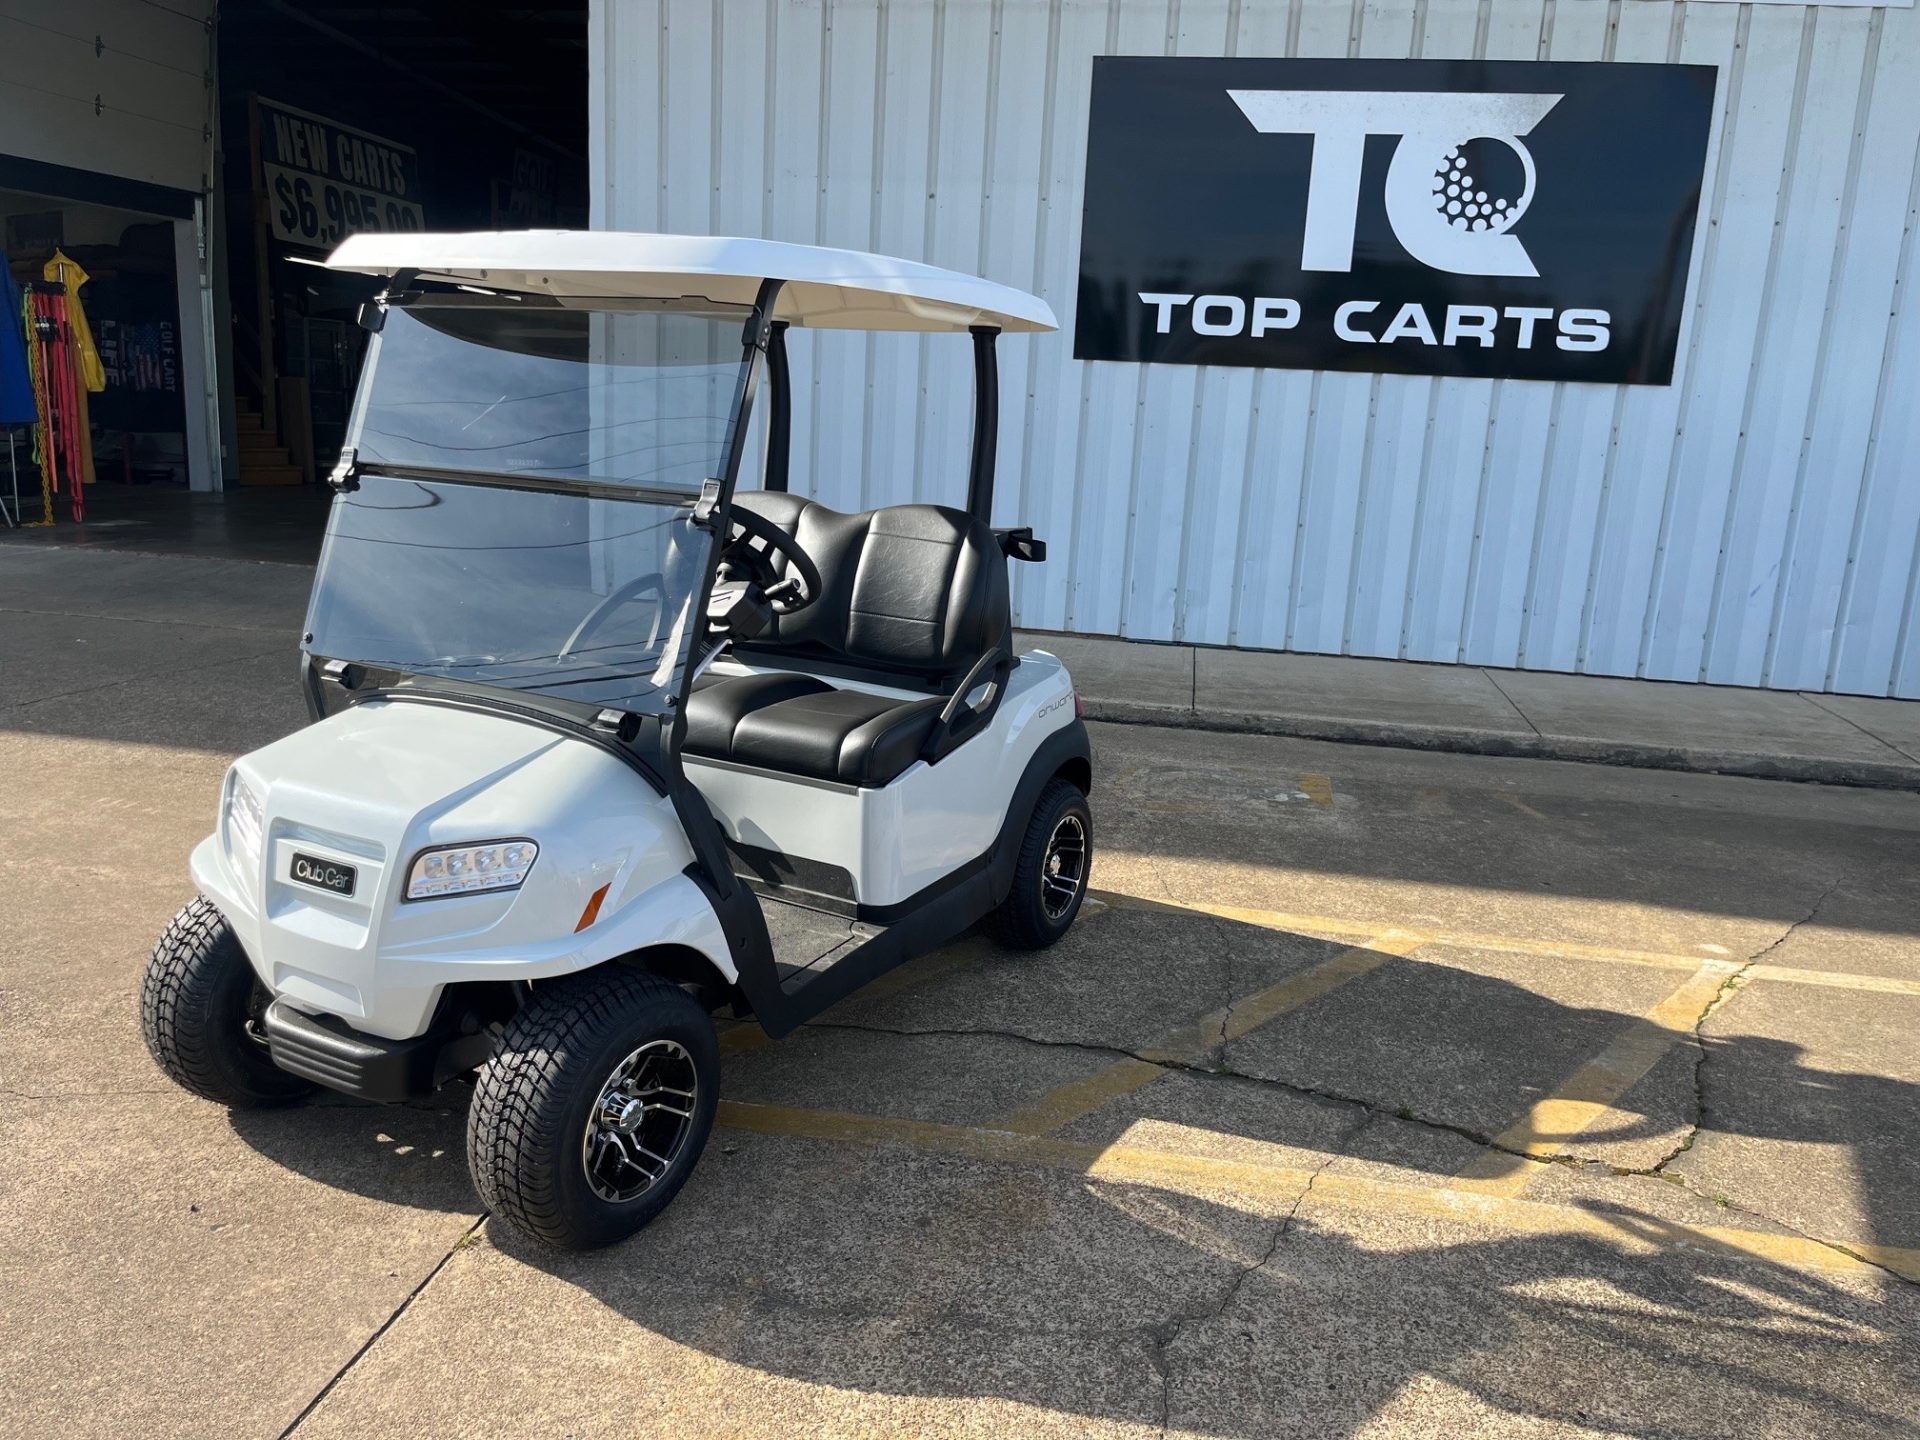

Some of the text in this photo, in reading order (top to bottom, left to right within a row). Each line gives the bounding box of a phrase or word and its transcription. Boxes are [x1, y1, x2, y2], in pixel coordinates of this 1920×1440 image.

[273, 113, 406, 195] NEW CARTS
[1138, 292, 1611, 352] TOP CARTS
[296, 859, 349, 888] Club Car
